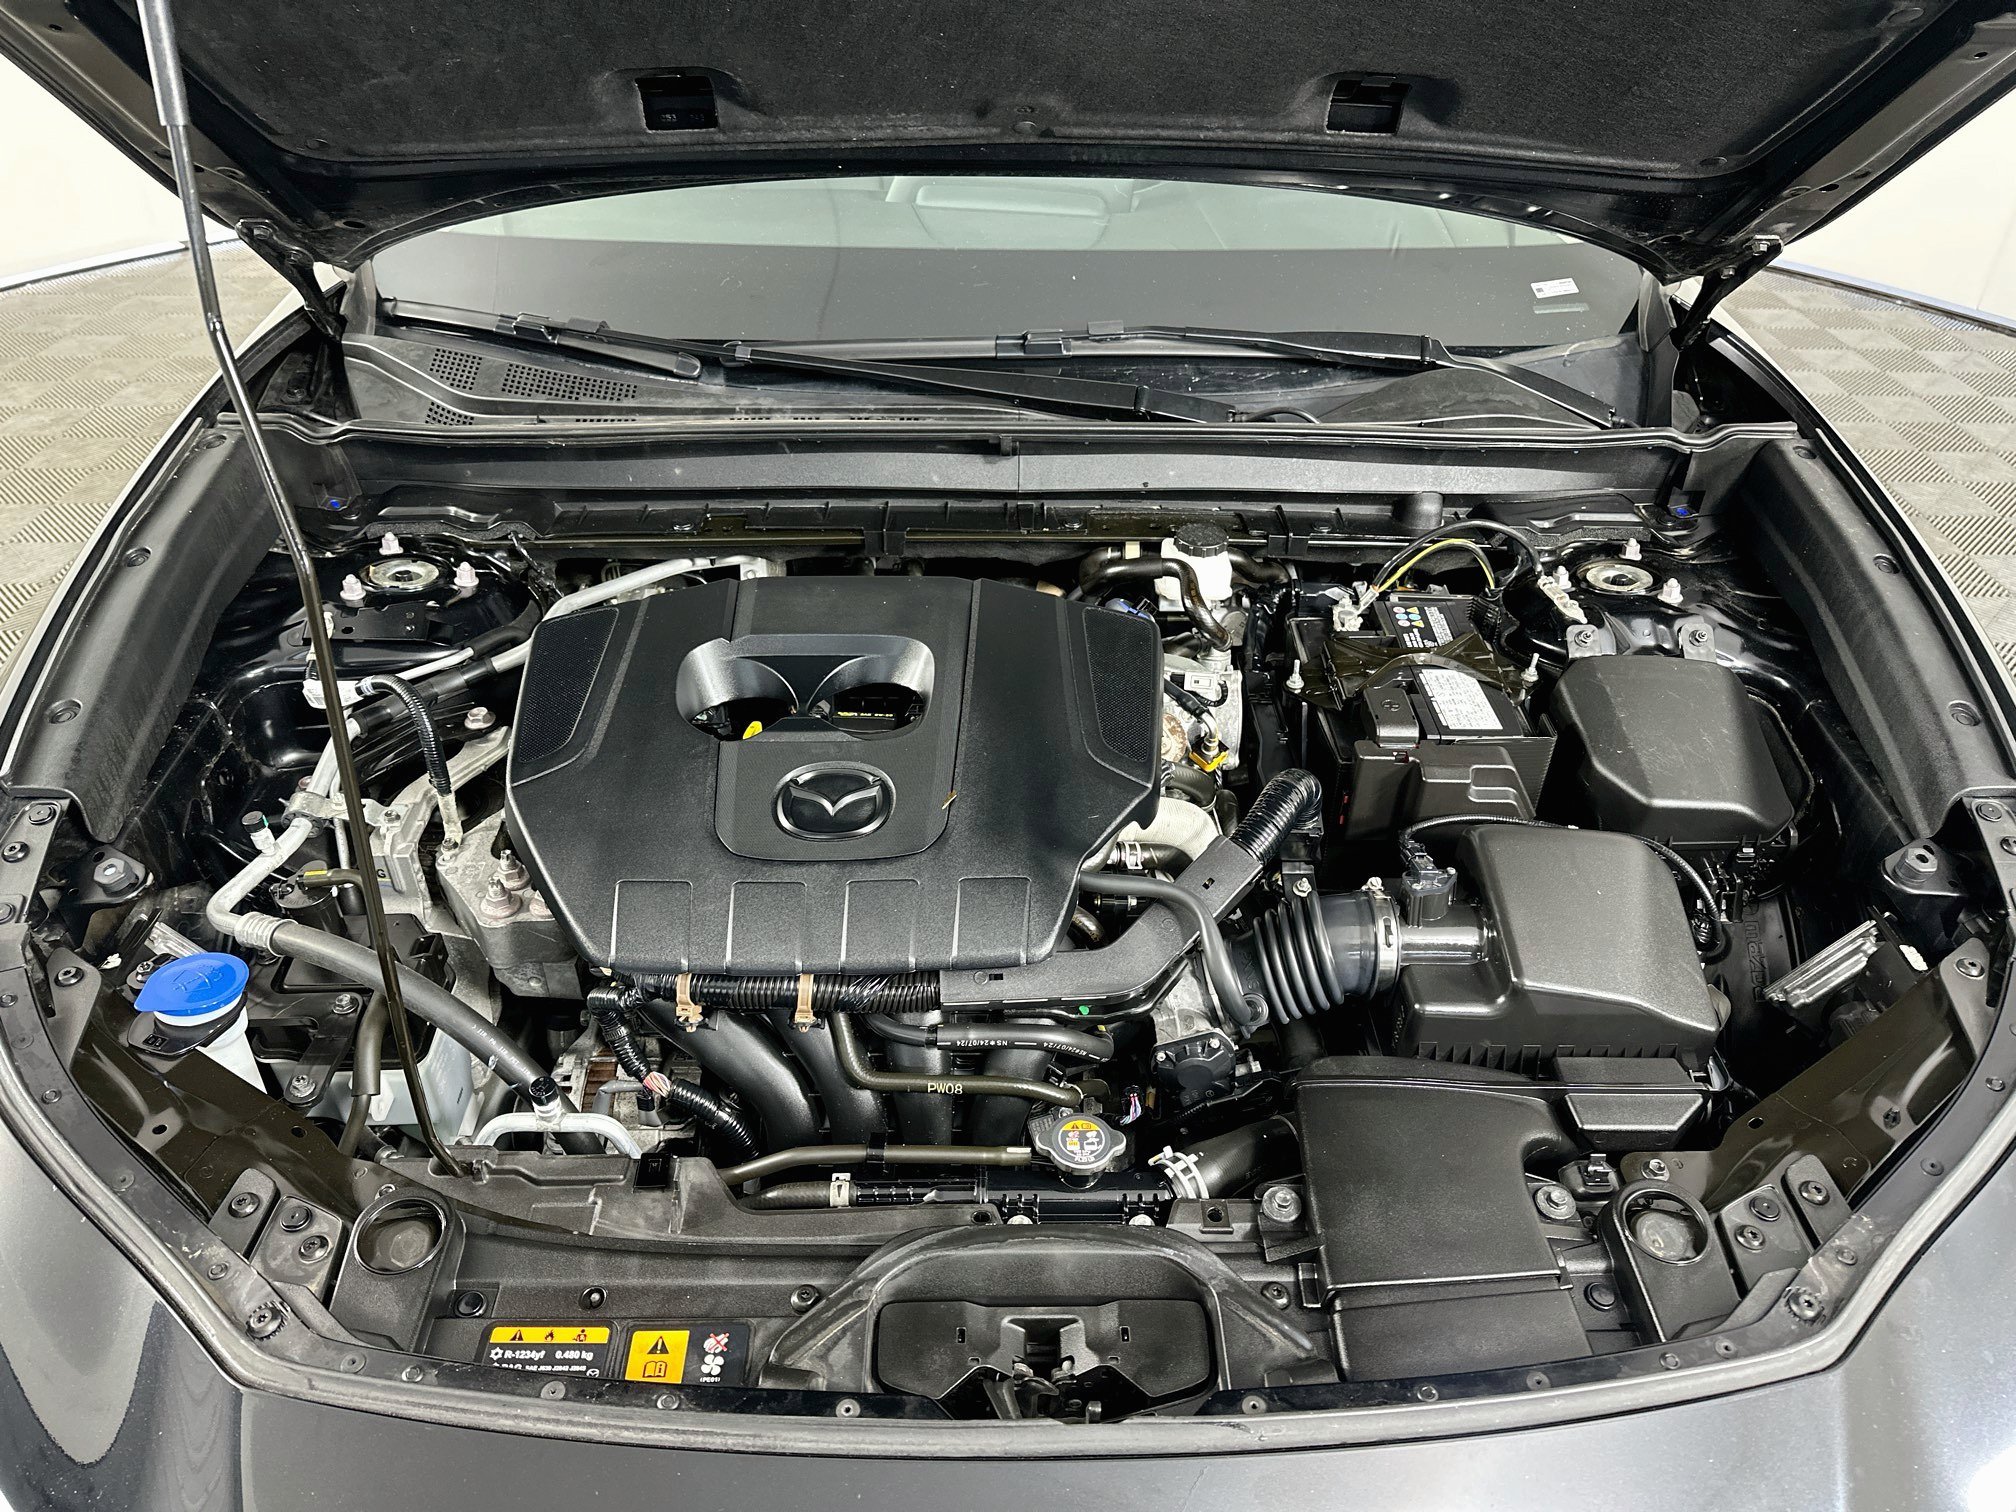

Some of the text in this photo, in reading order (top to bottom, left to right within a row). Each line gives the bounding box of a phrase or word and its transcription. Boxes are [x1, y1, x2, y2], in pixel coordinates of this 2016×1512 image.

[927, 1082, 963, 1095] PW08
[503, 1349, 546, 1361] R-1234yf
[580, 1350, 593, 1361] kg
